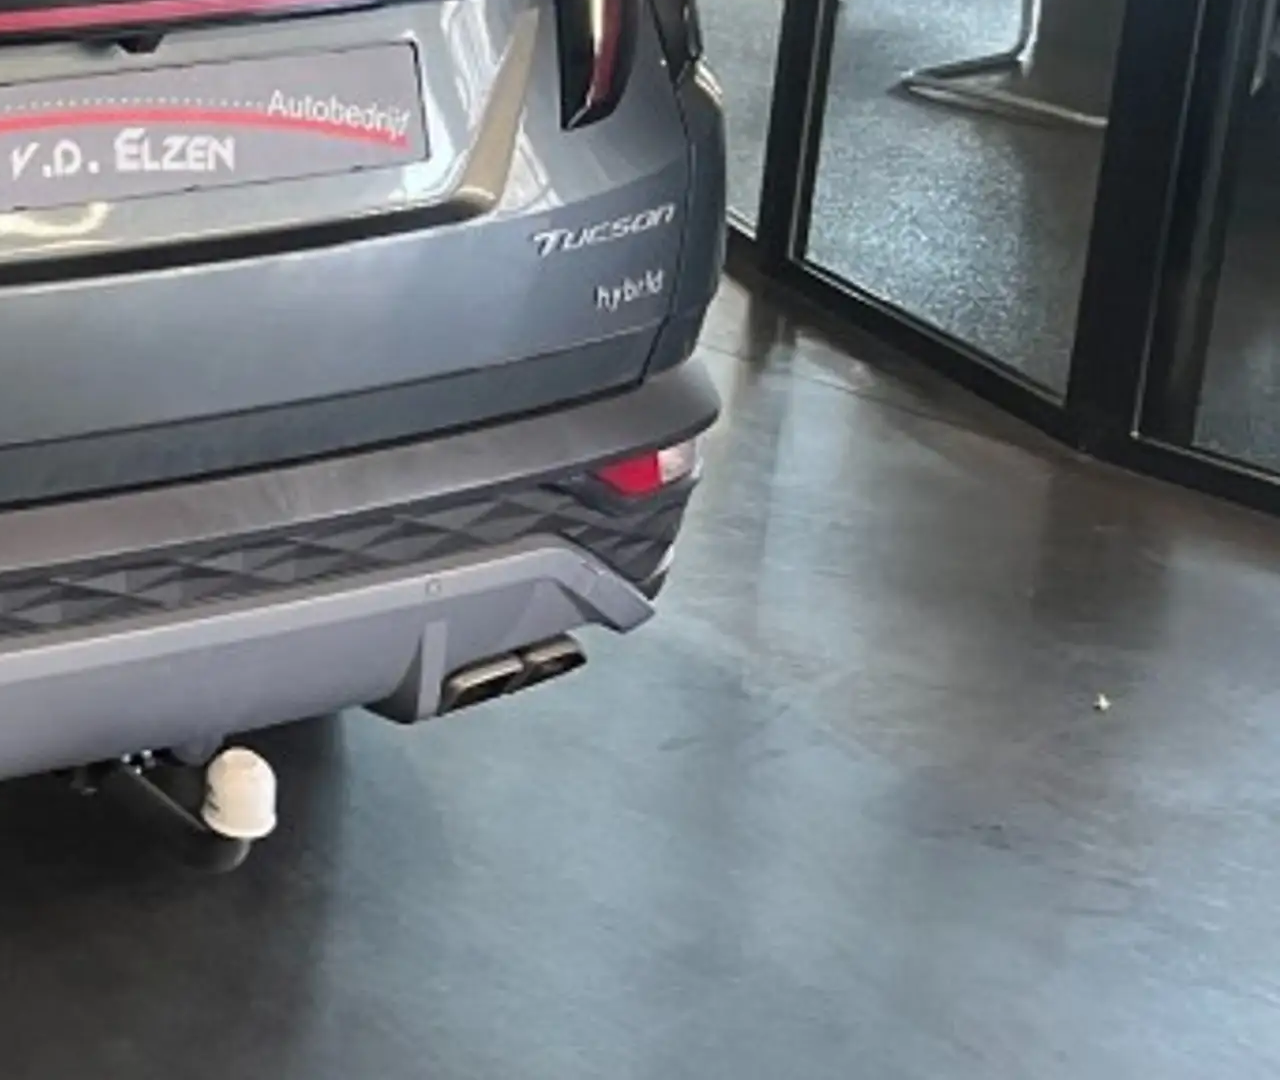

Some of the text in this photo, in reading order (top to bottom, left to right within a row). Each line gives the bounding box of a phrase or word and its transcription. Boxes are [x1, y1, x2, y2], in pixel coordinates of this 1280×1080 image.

[267, 88, 412, 142] Autobedrijf
[113, 126, 236, 172] ELZEN
[596, 268, 665, 314] hybrid
